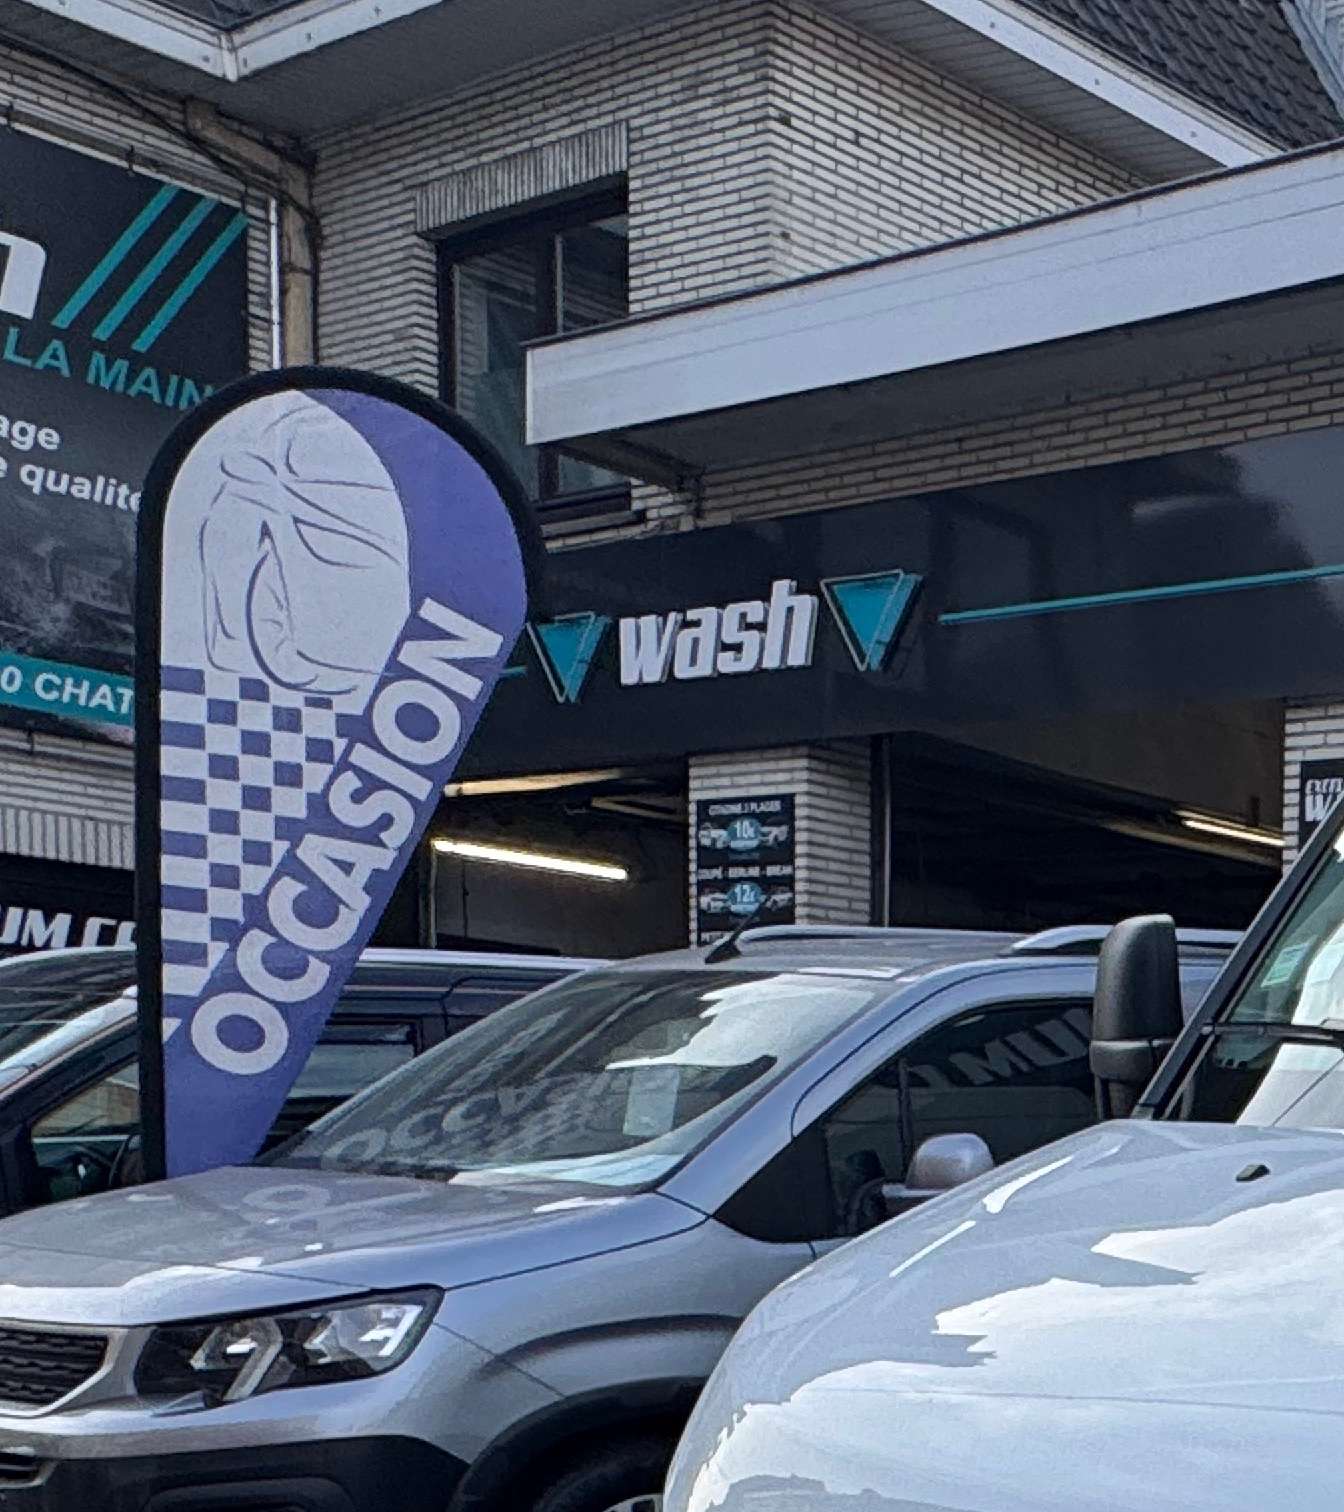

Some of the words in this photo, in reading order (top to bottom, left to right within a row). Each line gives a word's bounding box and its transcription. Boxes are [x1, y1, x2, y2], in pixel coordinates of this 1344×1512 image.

[4, 326, 71, 378] LA
[619, 579, 818, 686] wash
[191, 597, 503, 1076] OCCASION
